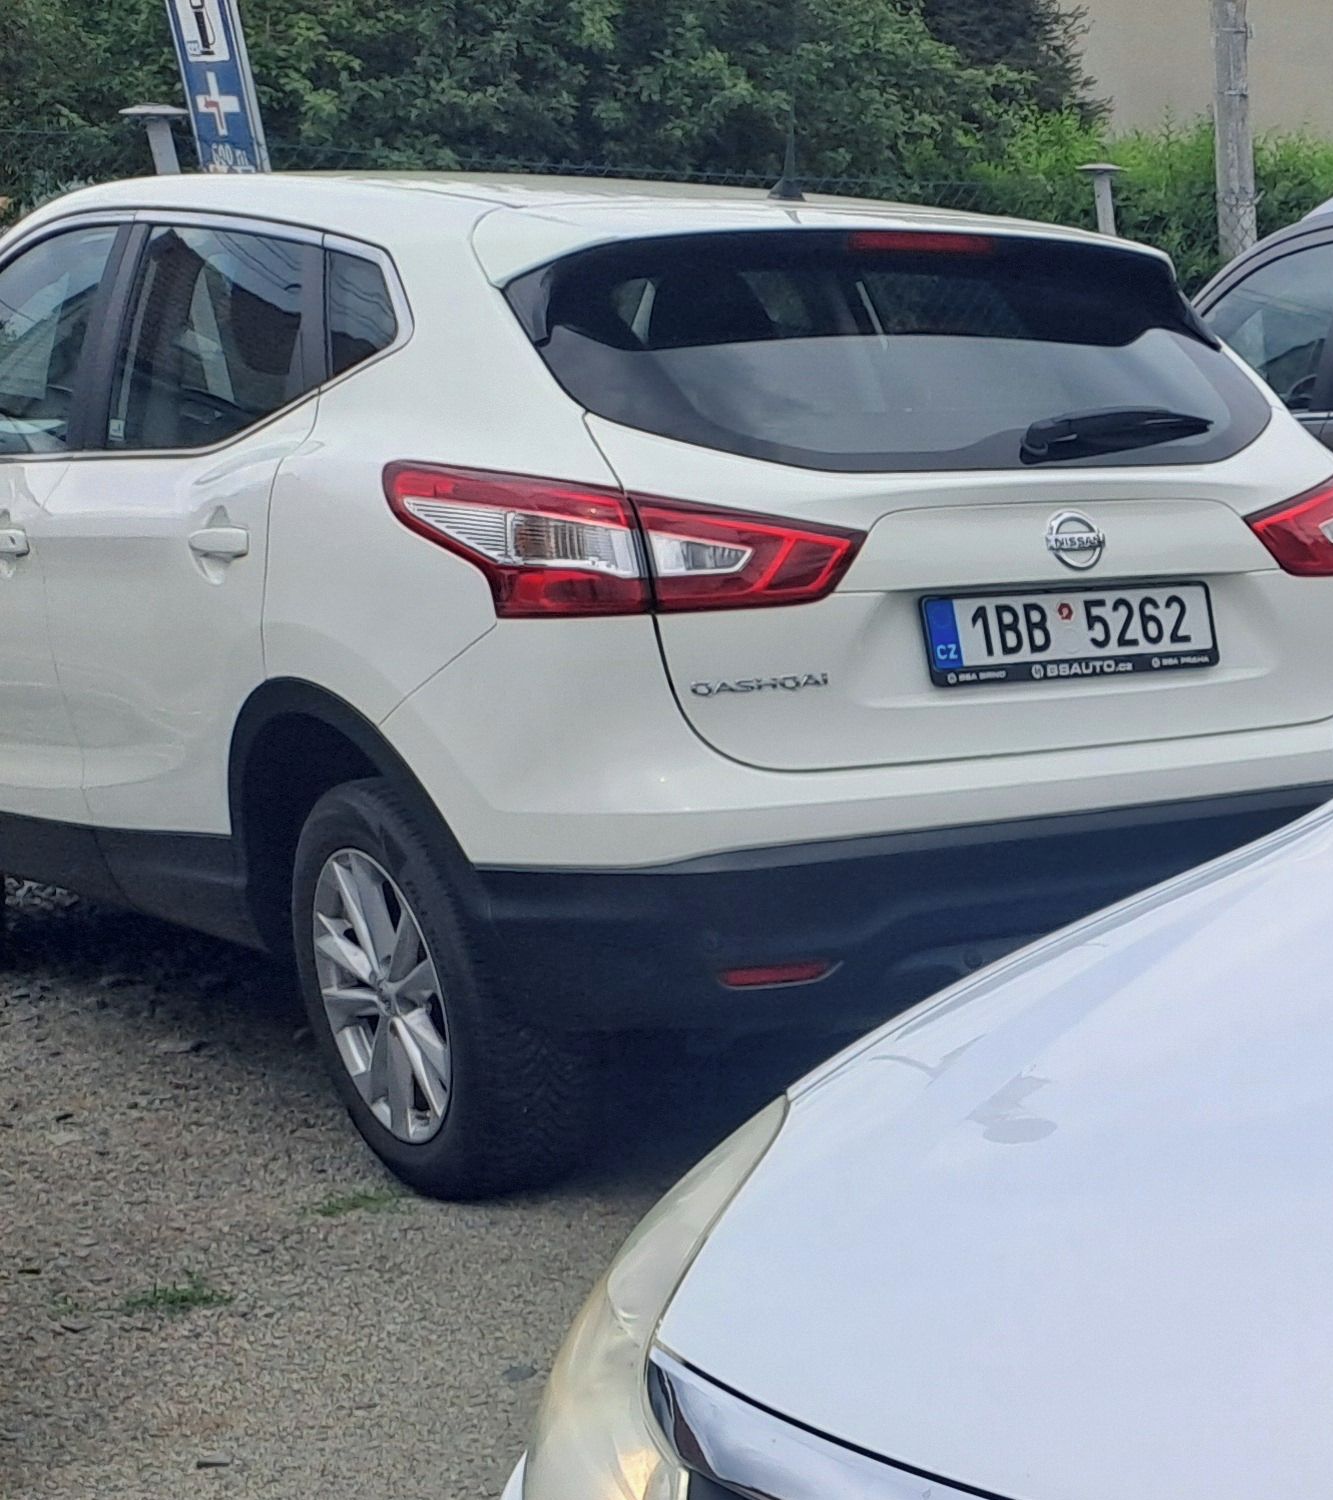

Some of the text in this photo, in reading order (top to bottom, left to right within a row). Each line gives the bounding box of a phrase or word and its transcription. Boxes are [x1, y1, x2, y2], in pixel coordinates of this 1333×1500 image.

[1054, 535, 1100, 547] NISSAN
[971, 595, 1192, 657] 1BB 5262
[936, 644, 958, 660] CZ
[690, 673, 829, 697] QASHQAI
